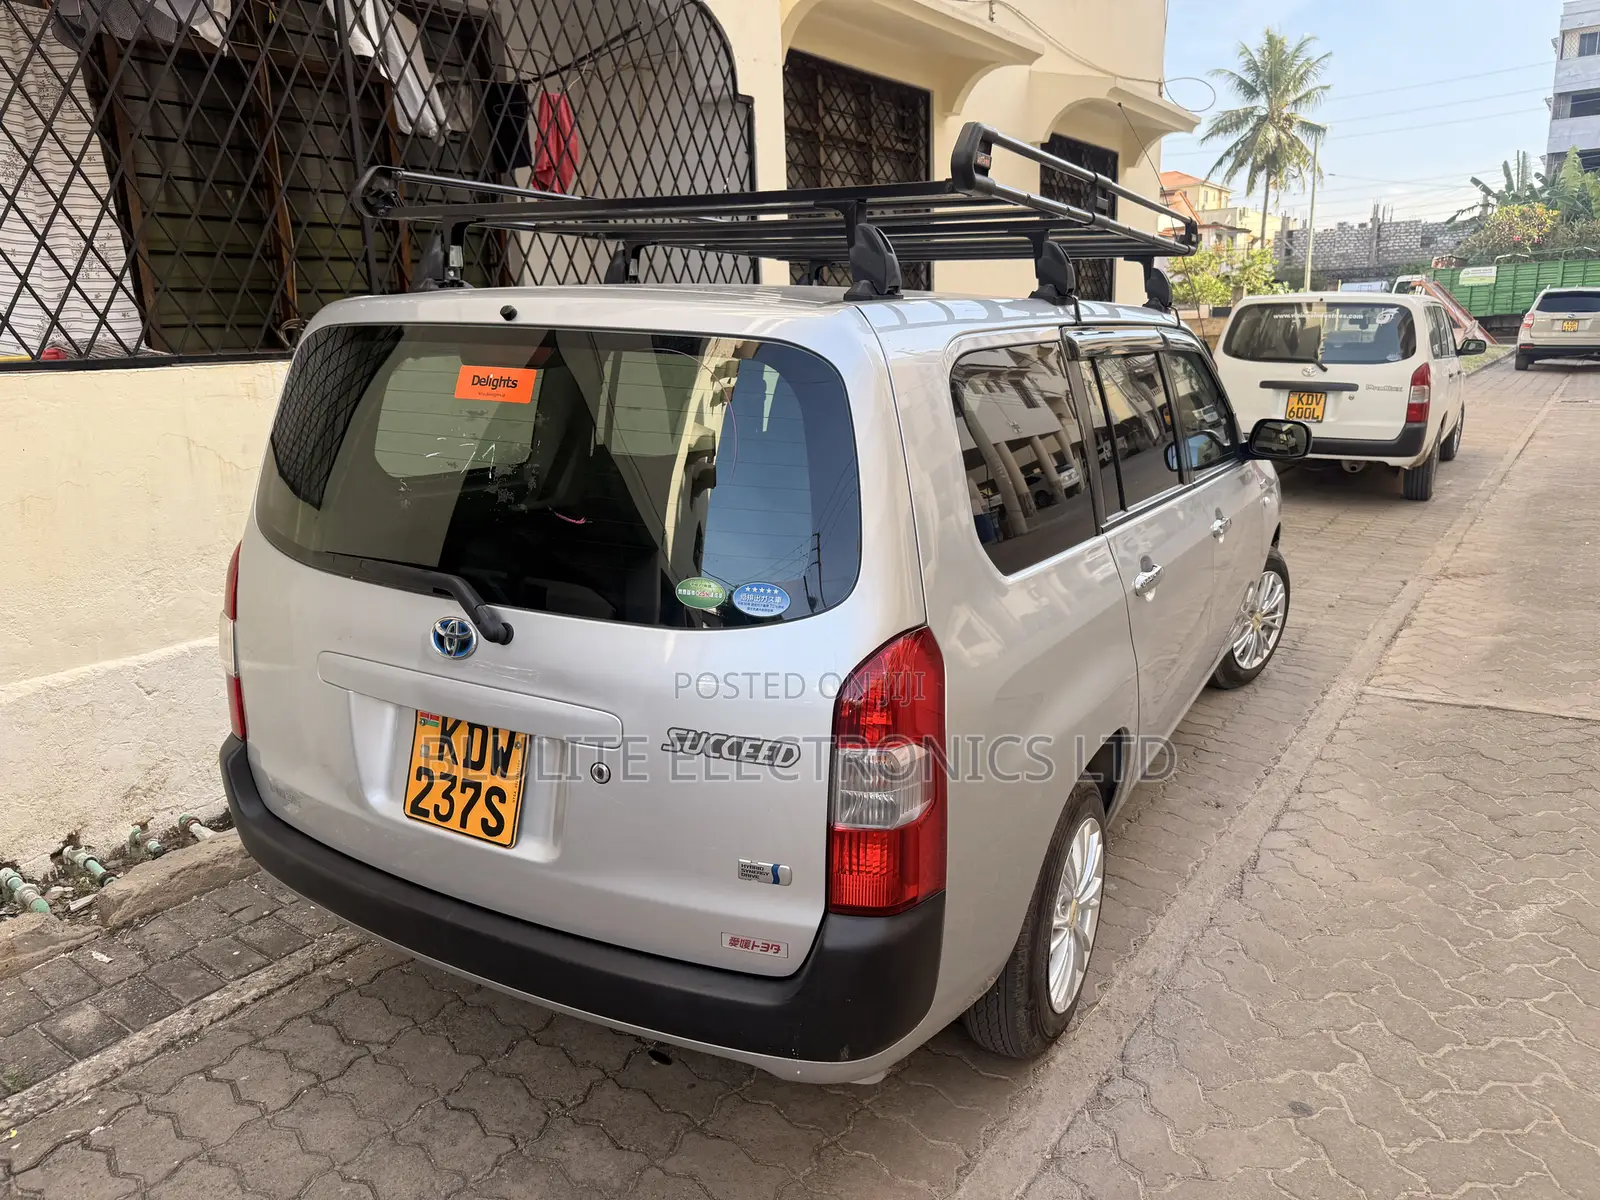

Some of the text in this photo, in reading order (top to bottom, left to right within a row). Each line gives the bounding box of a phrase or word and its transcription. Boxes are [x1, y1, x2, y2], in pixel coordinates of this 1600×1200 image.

[471, 373, 519, 390] Delights
[1296, 392, 1323, 406] KDV
[1287, 406, 1320, 420] 600L
[437, 715, 517, 779] KDW
[661, 726, 801, 769] SUCCEED
[409, 766, 507, 837] 237S
[741, 863, 764, 871] HYBRID
[741, 868, 770, 876] SYNERGY
[741, 872, 760, 880] DRIVE
[728, 936, 781, 954] 愛媛トヨタ
